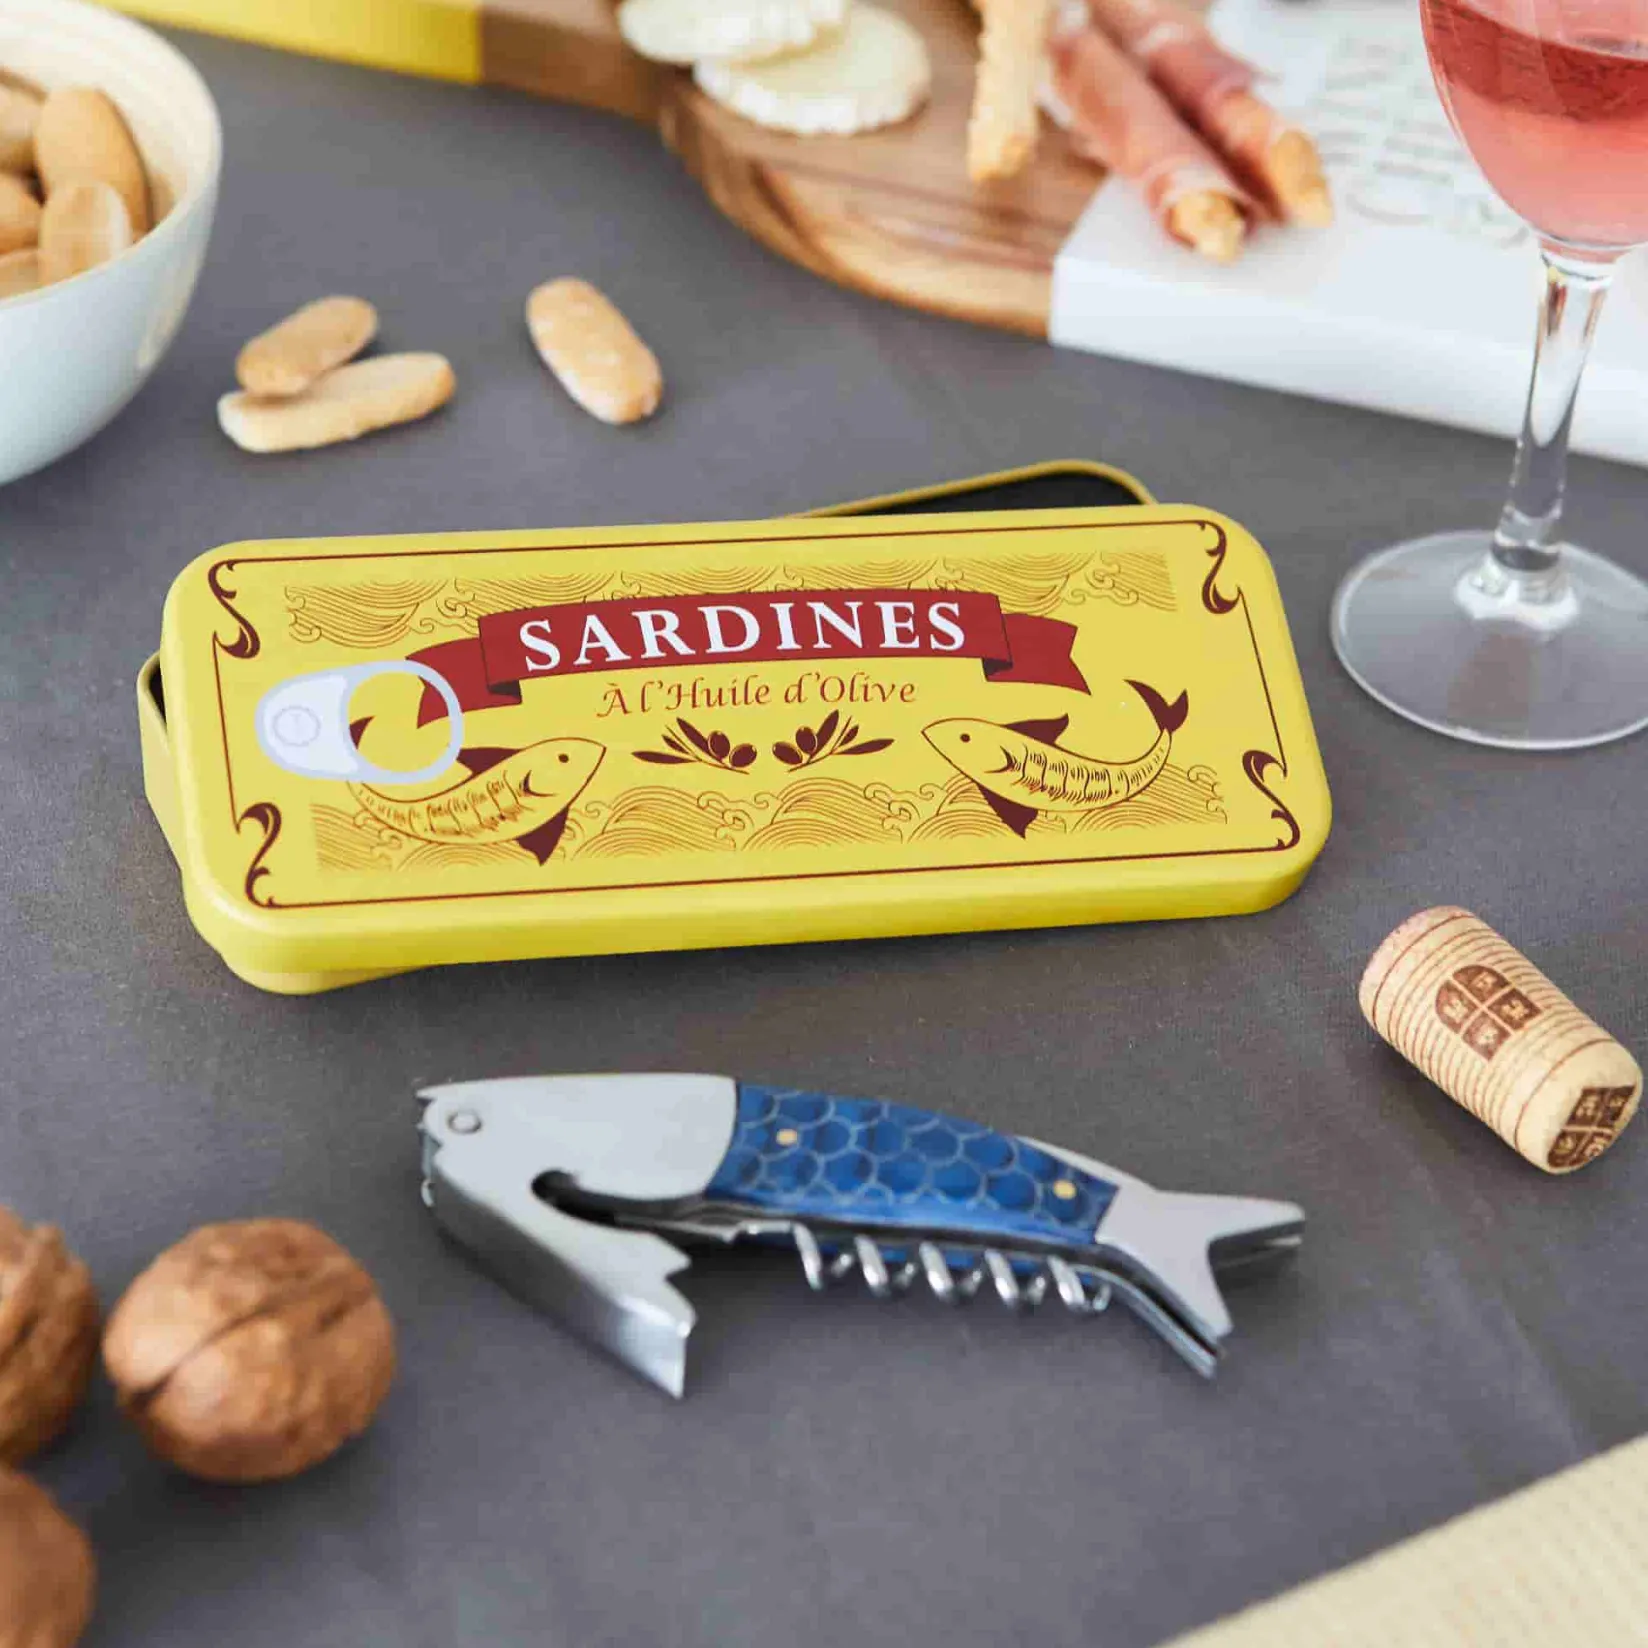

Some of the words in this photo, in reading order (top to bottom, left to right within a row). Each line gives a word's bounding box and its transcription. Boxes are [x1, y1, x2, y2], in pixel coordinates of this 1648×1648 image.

[519, 601, 966, 672] SARDINES
[596, 682, 632, 718] À
[640, 674, 771, 712] l’Huile
[784, 671, 917, 704] d’Olive
